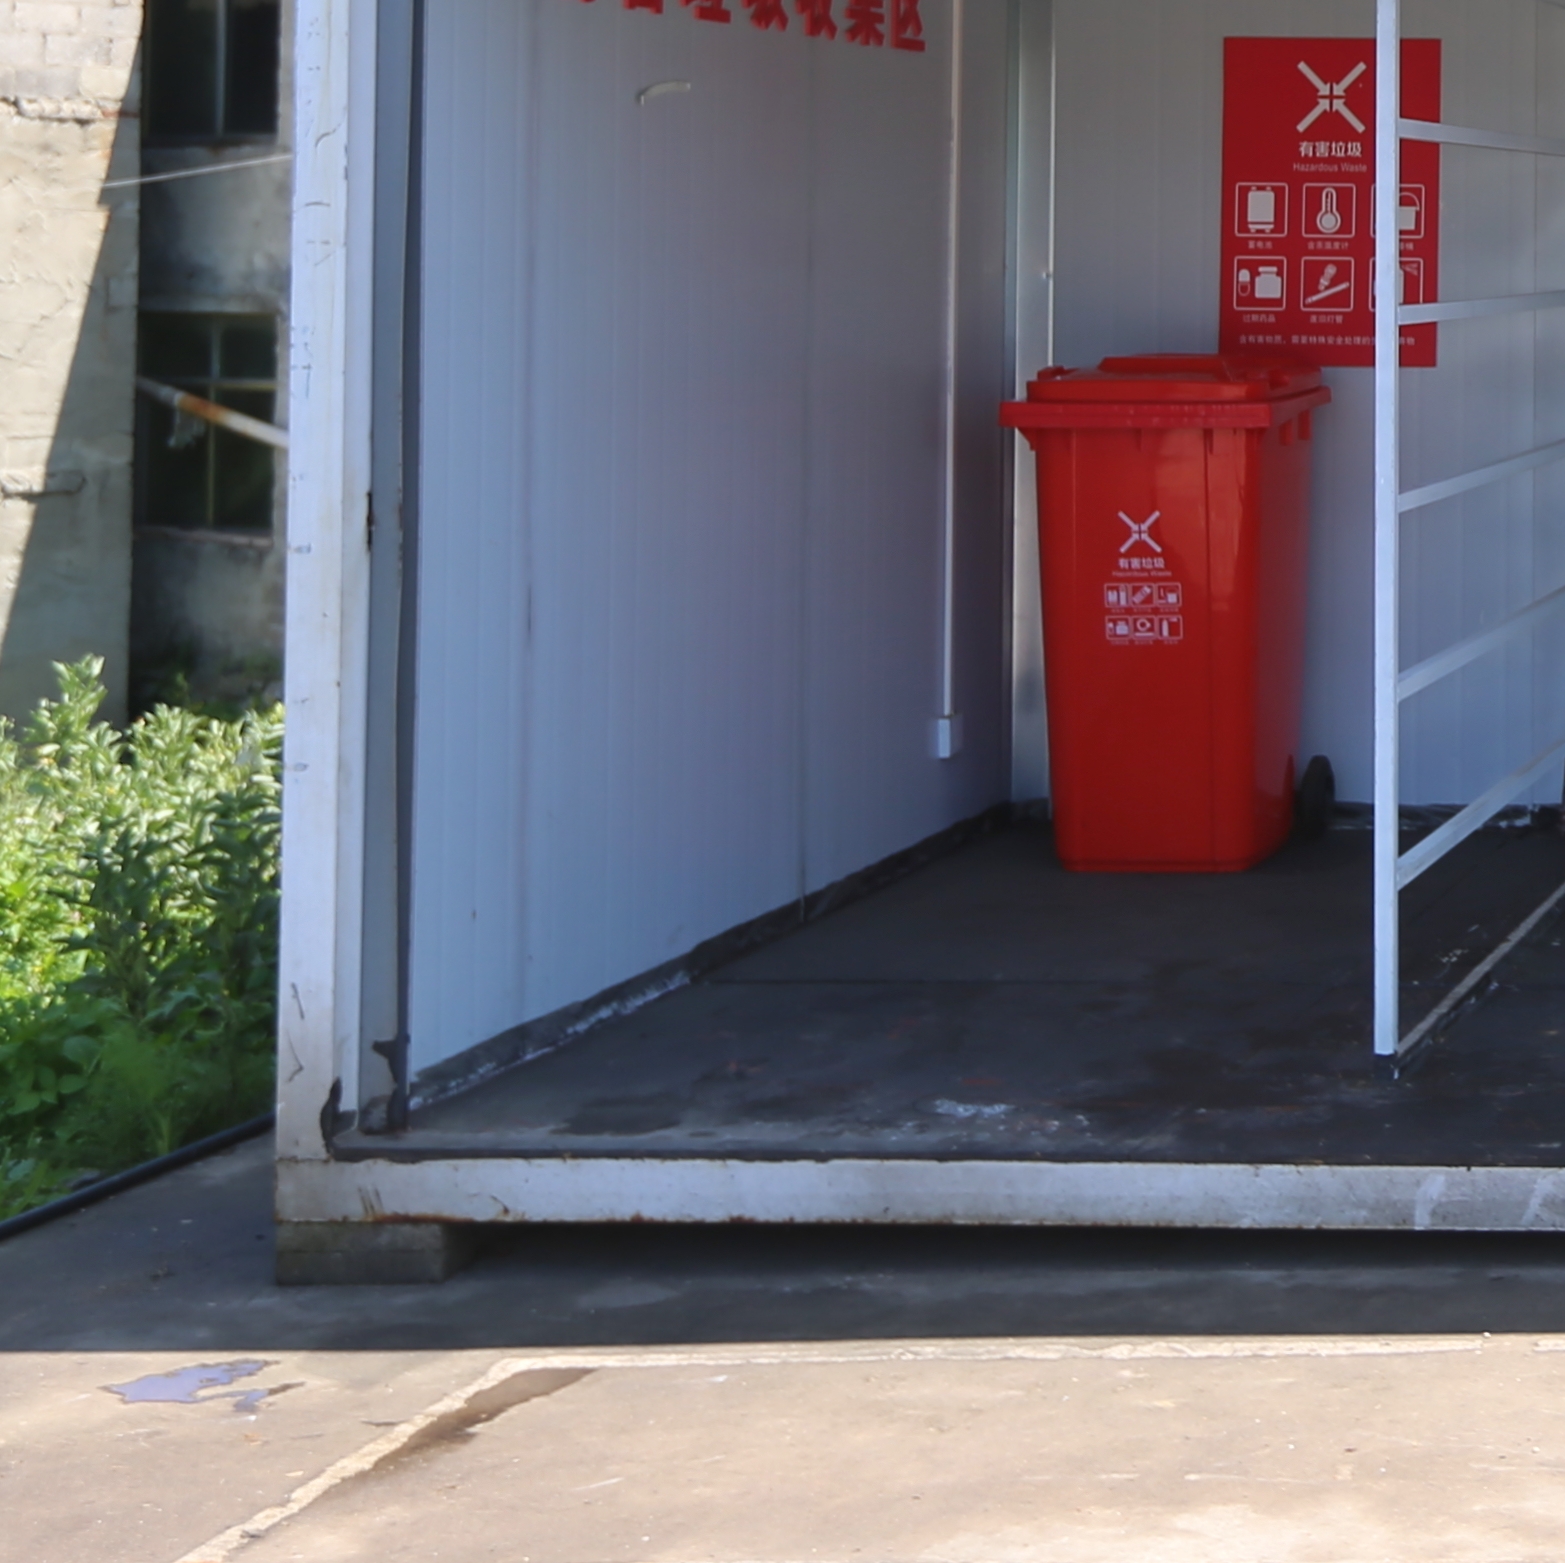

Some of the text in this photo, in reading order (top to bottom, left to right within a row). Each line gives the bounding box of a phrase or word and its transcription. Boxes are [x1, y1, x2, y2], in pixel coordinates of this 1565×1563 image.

[1299, 141, 1362, 158] 有害垃圾
[1293, 162, 1367, 173] Hazardous Waste
